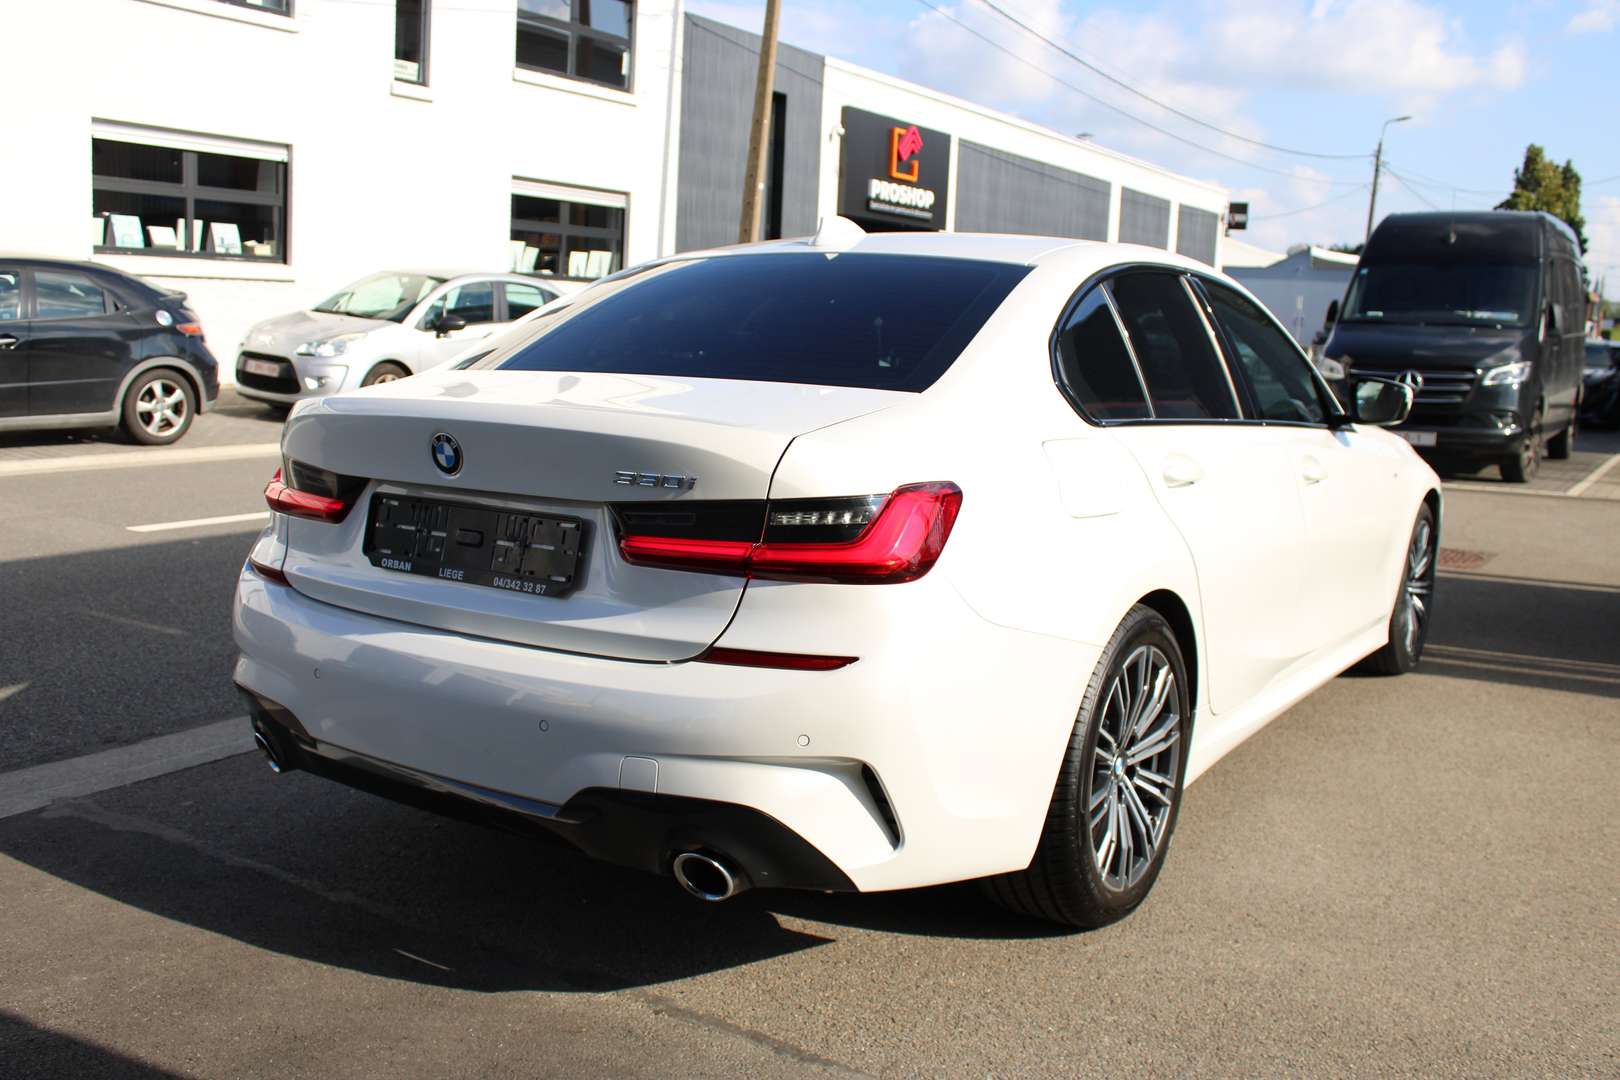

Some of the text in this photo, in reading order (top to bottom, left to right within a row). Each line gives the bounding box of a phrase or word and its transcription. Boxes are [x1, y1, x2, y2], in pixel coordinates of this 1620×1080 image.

[868, 178, 935, 209] PROSHOP
[613, 470, 697, 490] 330i
[381, 558, 547, 595] ORBAN LIEGE 04/342 32 87
